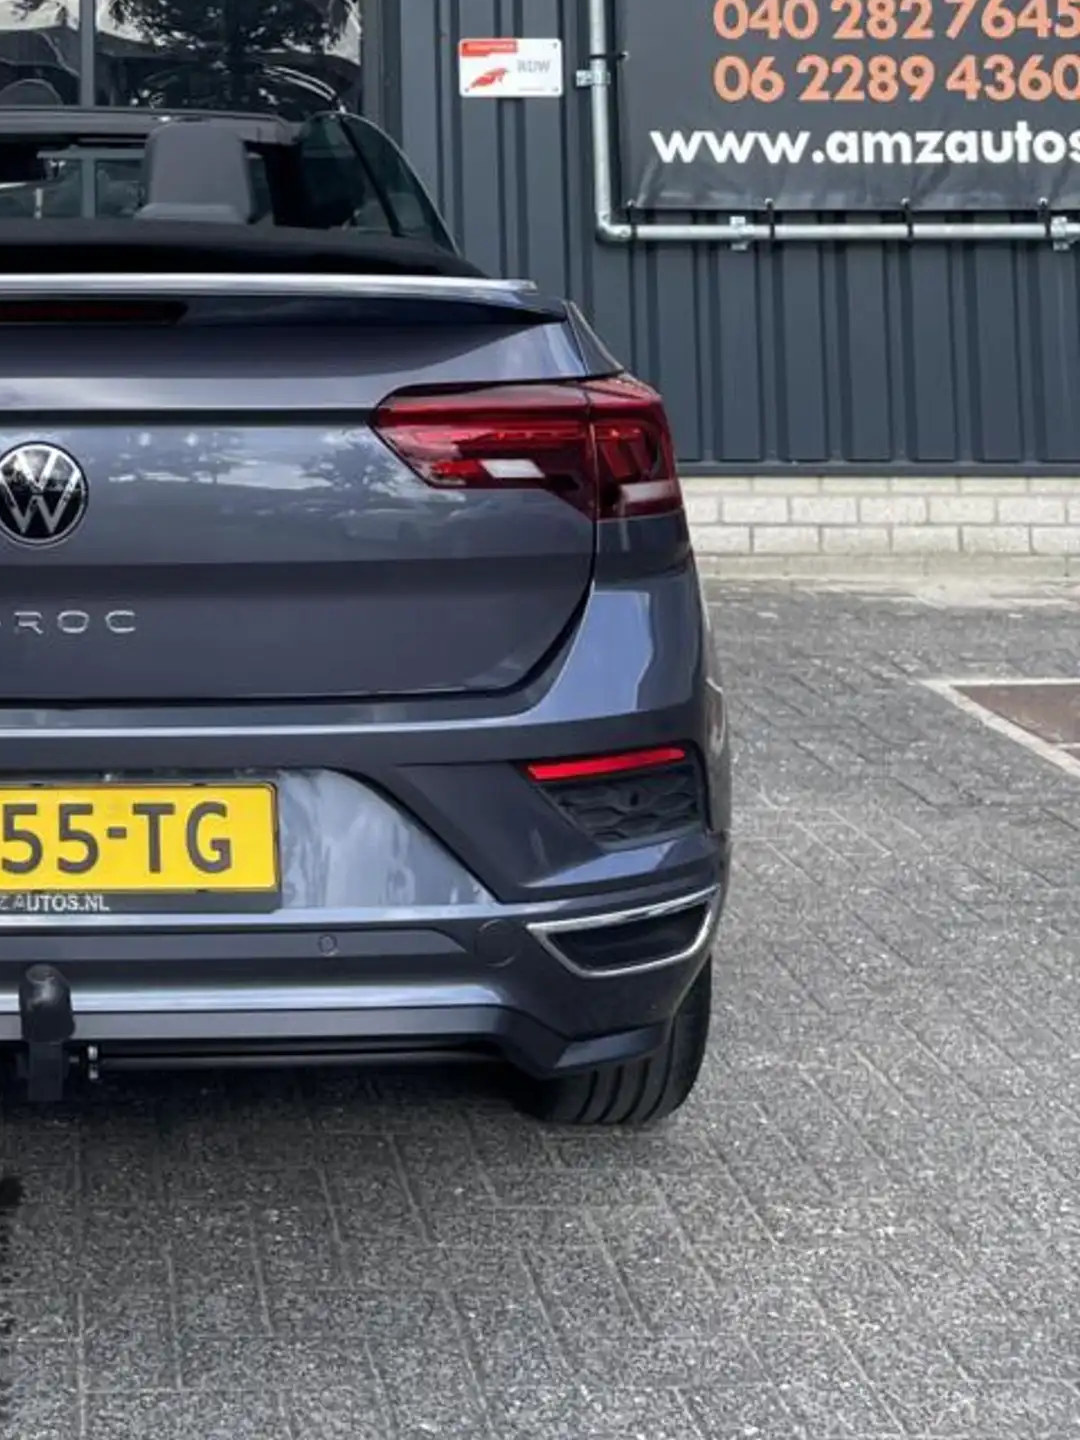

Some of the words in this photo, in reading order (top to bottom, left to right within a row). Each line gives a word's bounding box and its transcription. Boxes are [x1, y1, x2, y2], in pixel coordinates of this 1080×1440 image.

[713, 54, 786, 102] 06
[796, 54, 935, 102] 2289
[945, 53, 1080, 102] 4360
